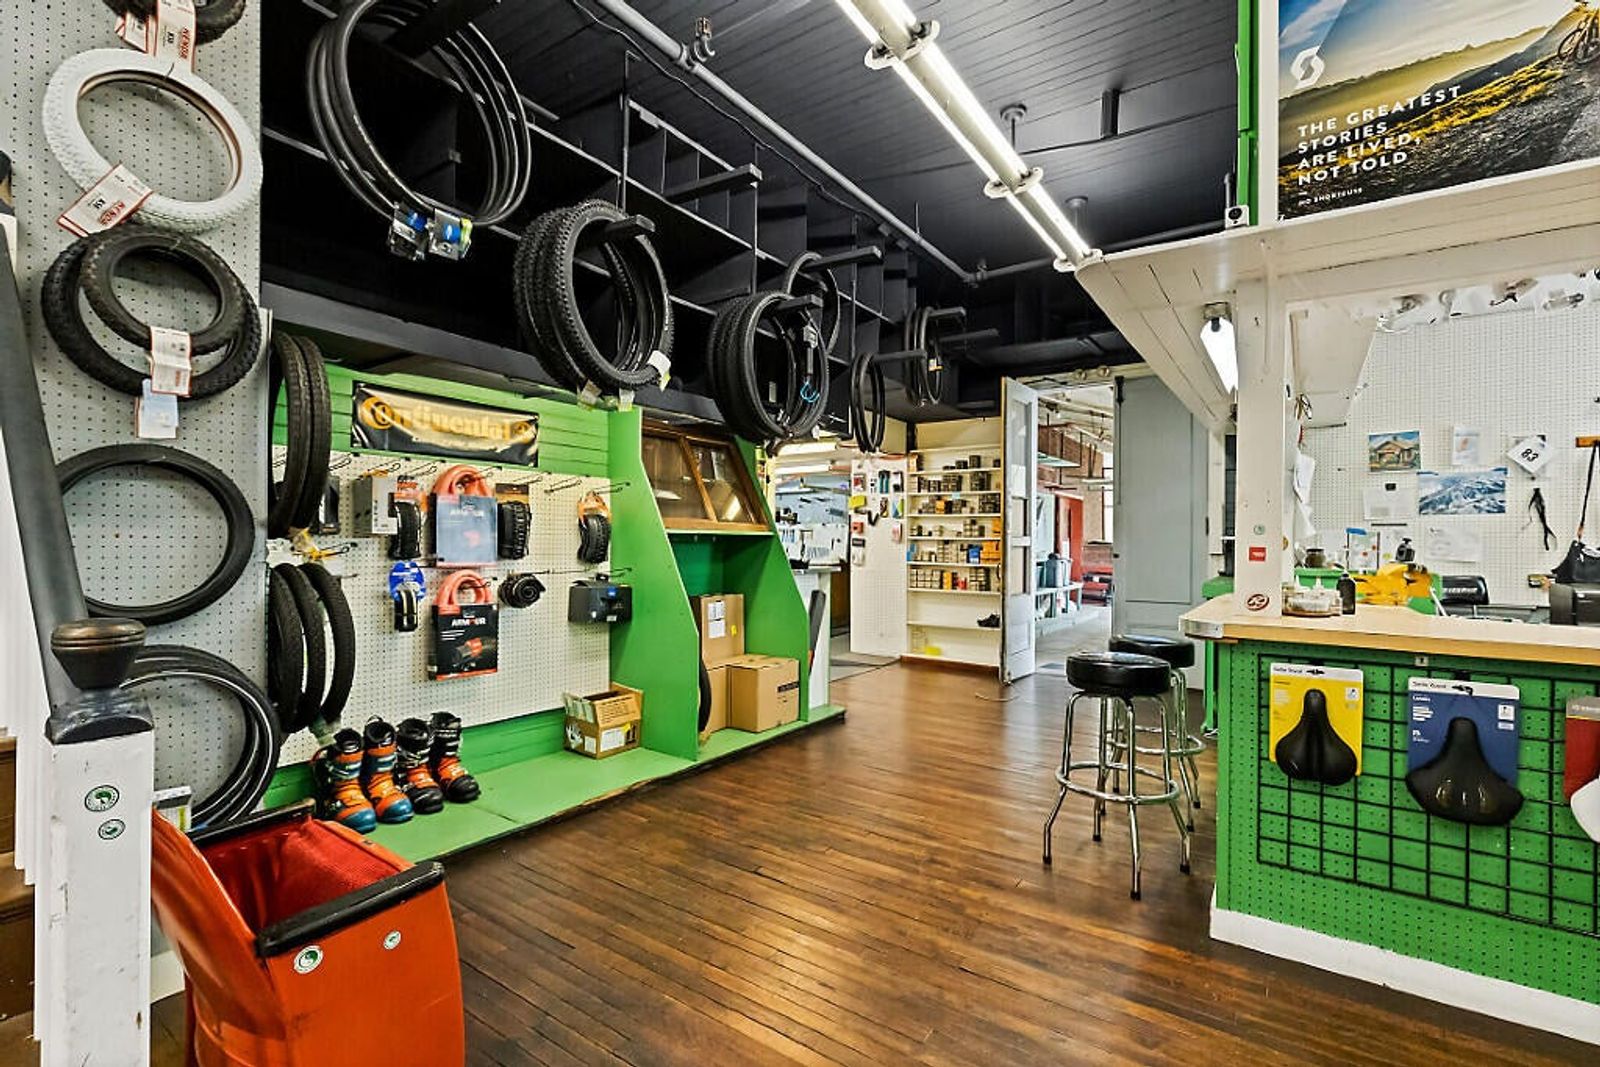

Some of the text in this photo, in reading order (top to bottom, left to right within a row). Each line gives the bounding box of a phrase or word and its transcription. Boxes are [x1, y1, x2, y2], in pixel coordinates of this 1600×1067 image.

[1298, 85, 1462, 137] THE GREATEST
[1297, 132, 1422, 170] ARE LIVED,
[1298, 121, 1389, 154] STORIES
[1298, 151, 1408, 186] NOT TOLD
[1521, 448, 1539, 462] 83
